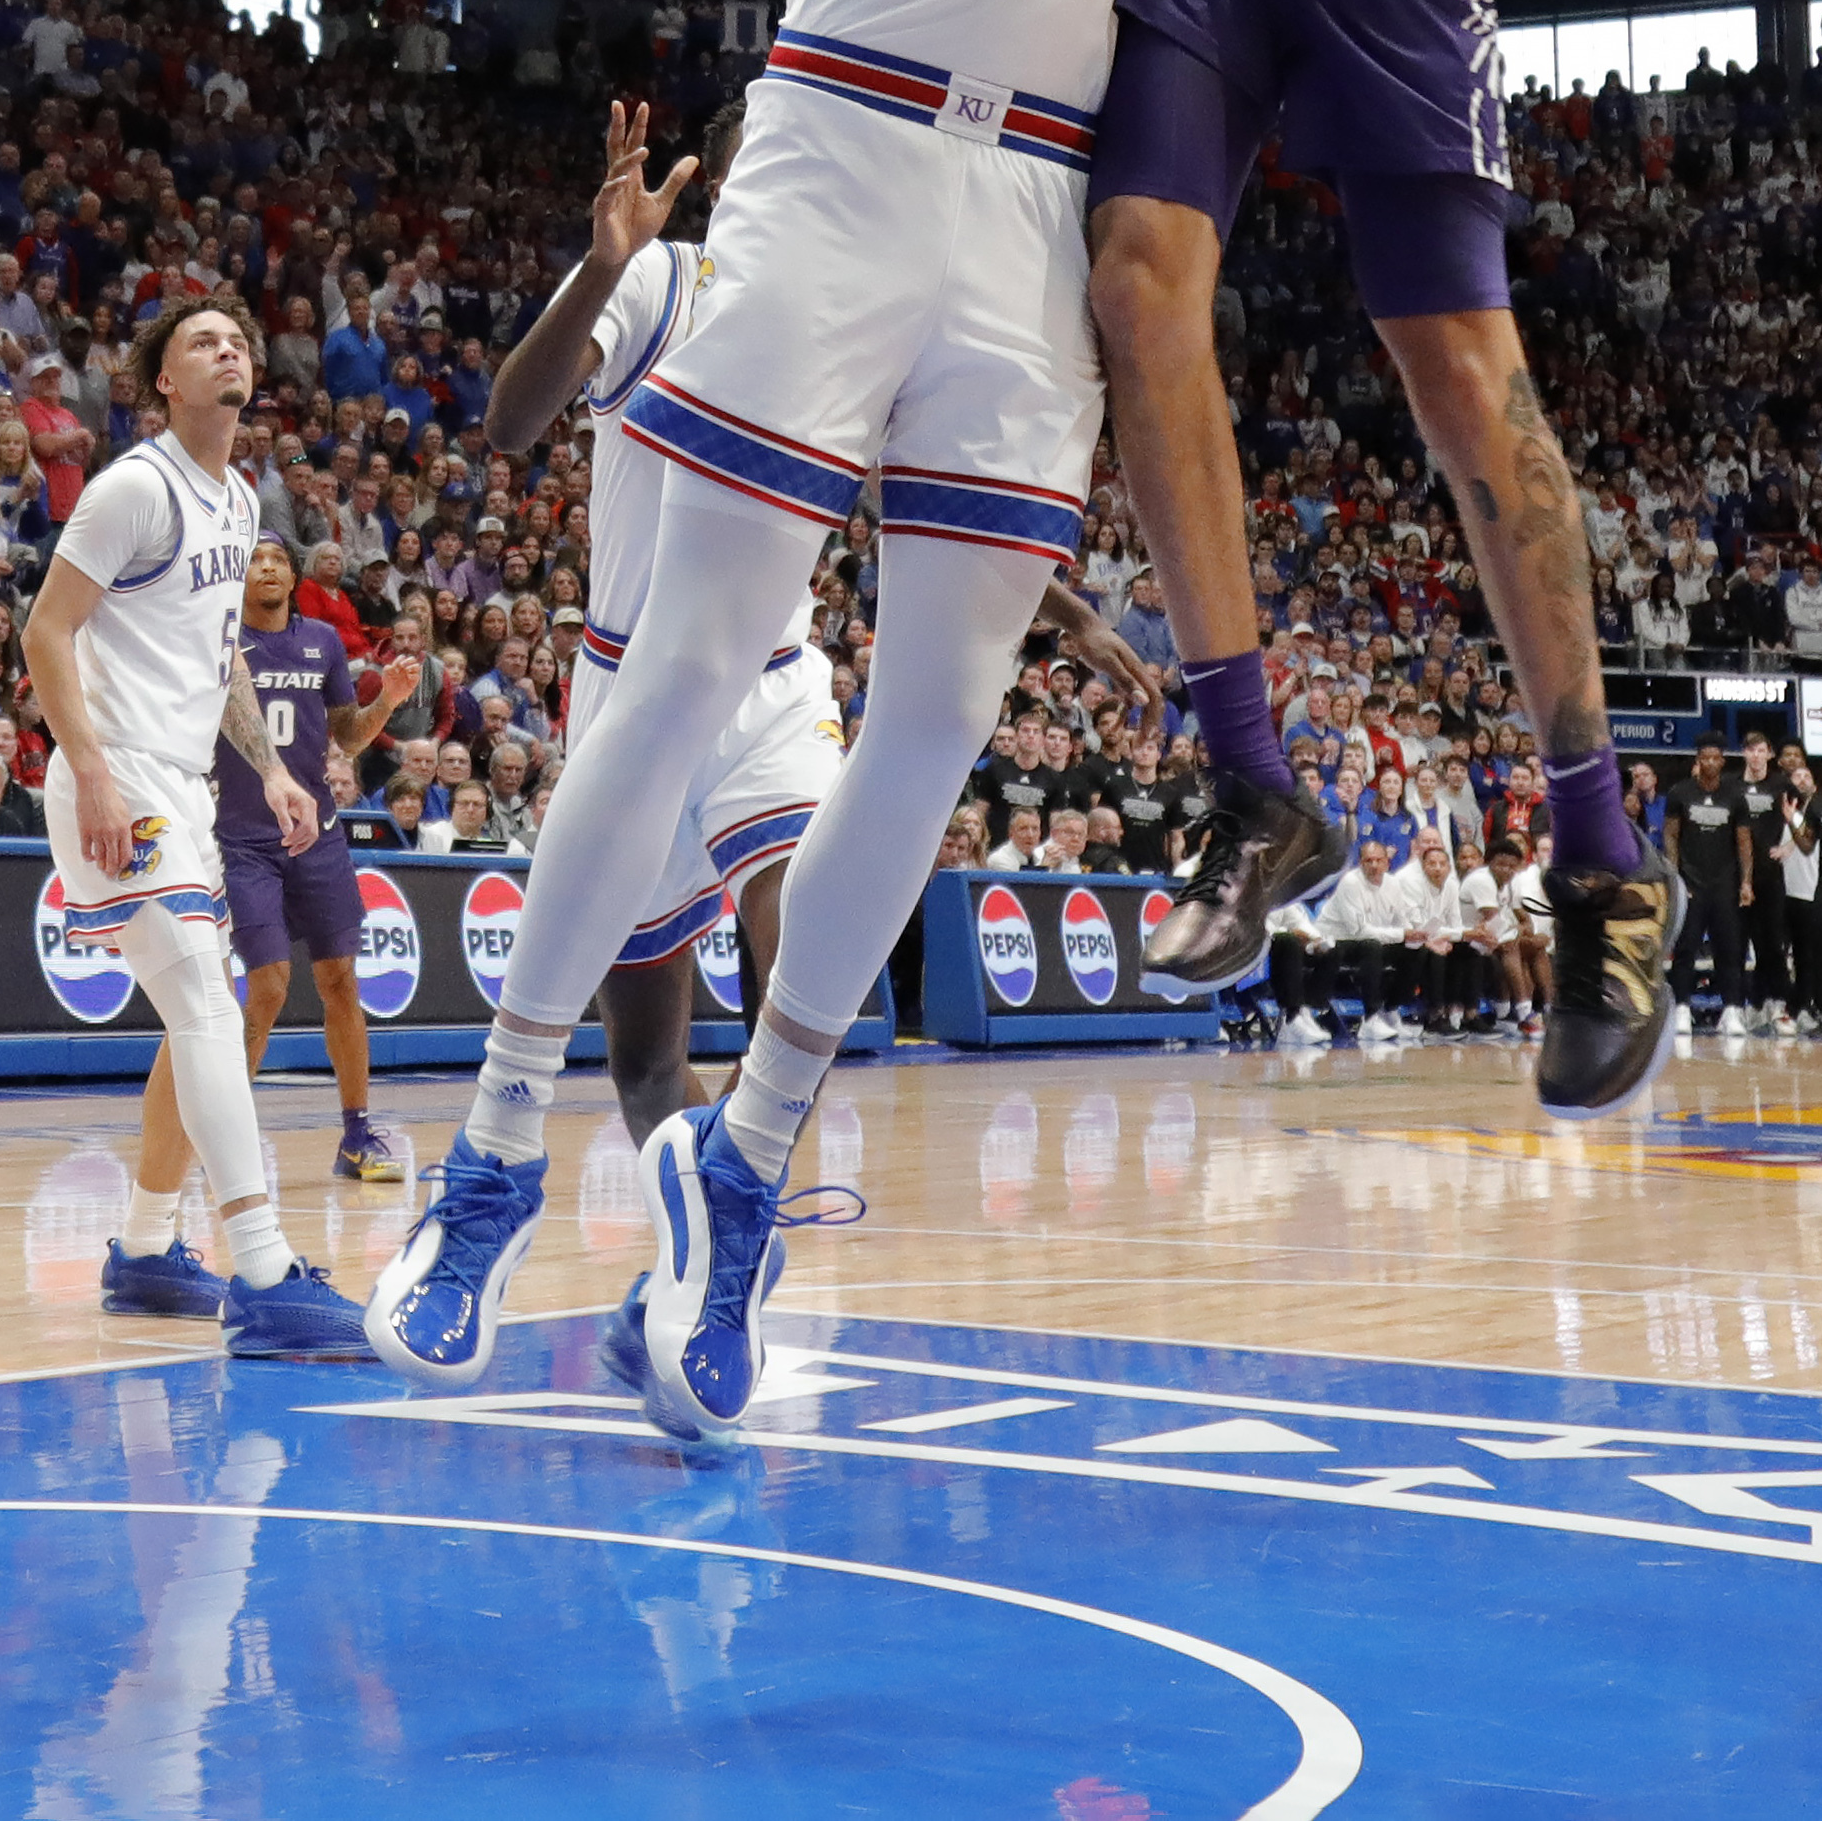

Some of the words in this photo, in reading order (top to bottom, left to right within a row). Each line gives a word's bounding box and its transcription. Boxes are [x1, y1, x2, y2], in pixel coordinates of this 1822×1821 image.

[954, 94, 996, 125] KU
[266, 700, 295, 749] 0
[1614, 725, 1655, 739] PERIOD
[1663, 721, 1675, 743] 2
[360, 927, 417, 959] EPSI
[468, 929, 514, 959] PEP
[982, 932, 1035, 960] PEPSI
[1064, 932, 1115, 960] PEPSI
